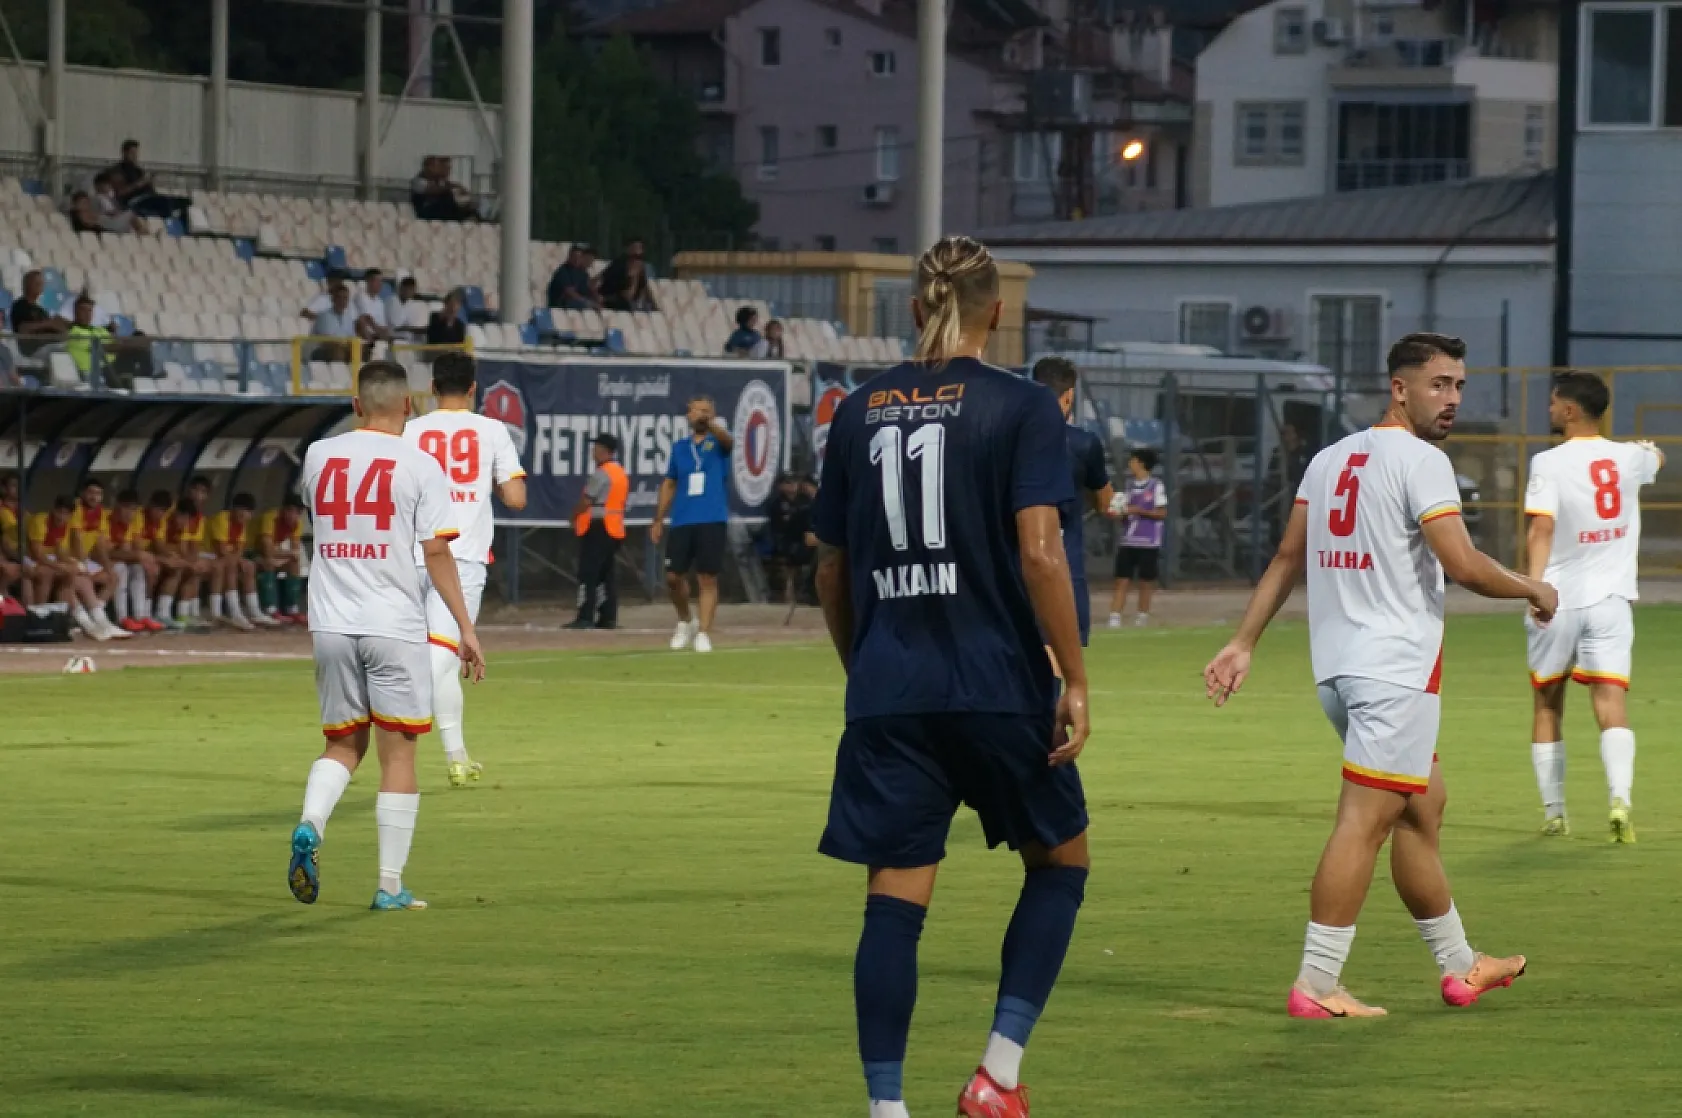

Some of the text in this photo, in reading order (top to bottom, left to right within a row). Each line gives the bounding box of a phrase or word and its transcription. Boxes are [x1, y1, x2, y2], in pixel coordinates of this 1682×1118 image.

[865, 401, 962, 425] BETON
[418, 429, 480, 484] 99
[869, 423, 946, 551] 11
[315, 457, 397, 531] 44
[1328, 452, 1370, 537] 5
[1588, 458, 1621, 520] 8
[319, 543, 390, 560] FERHAT
